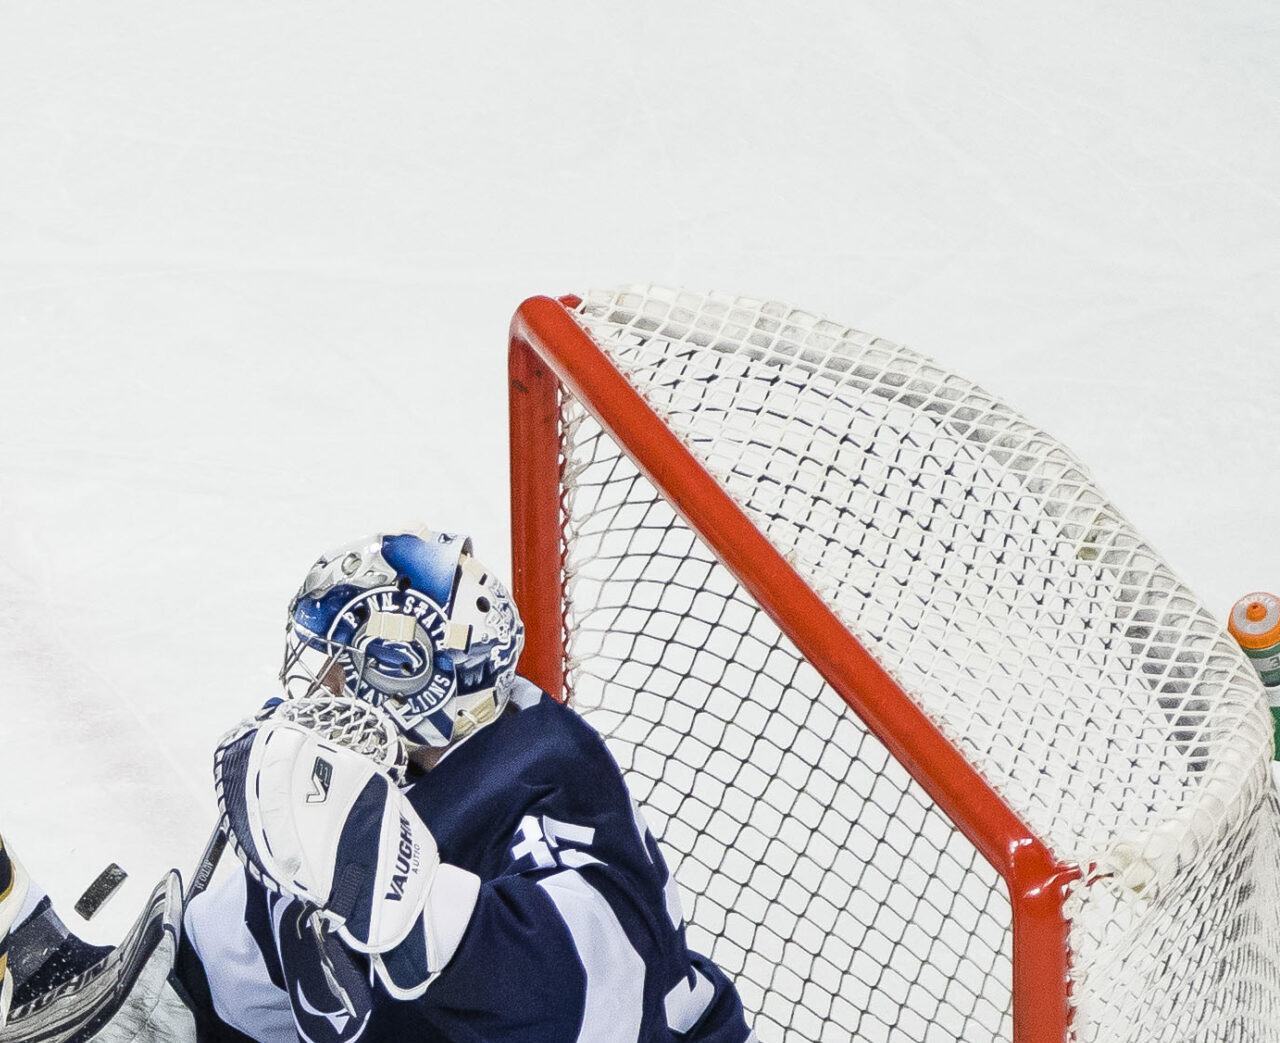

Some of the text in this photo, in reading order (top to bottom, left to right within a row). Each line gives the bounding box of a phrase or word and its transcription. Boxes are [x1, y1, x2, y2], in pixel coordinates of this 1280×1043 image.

[342, 592, 396, 630] PNN
[407, 673, 451, 714] LIONS
[384, 811, 413, 902] VAUGHN
